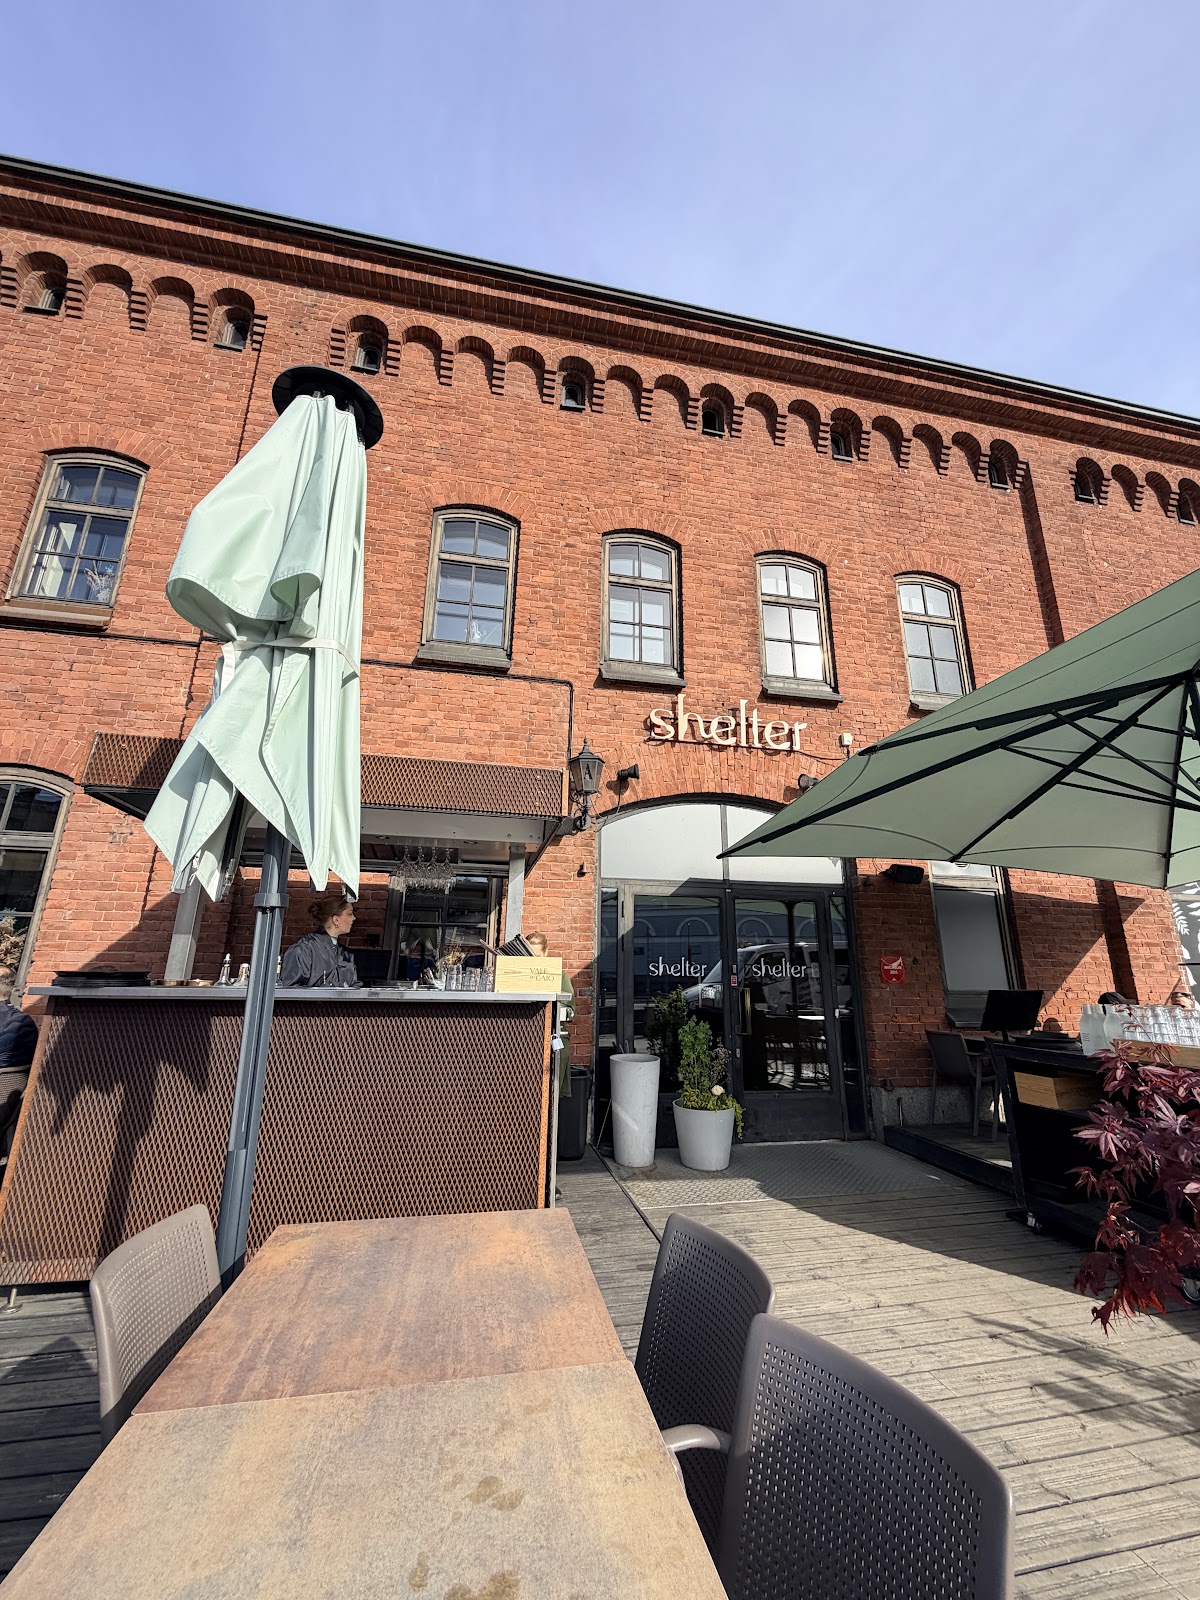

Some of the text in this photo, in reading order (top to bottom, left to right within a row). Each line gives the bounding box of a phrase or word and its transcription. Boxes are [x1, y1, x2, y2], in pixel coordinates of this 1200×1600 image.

[650, 693, 807, 750] shelter
[649, 956, 707, 977] shelter
[752, 957, 807, 977] shelter
